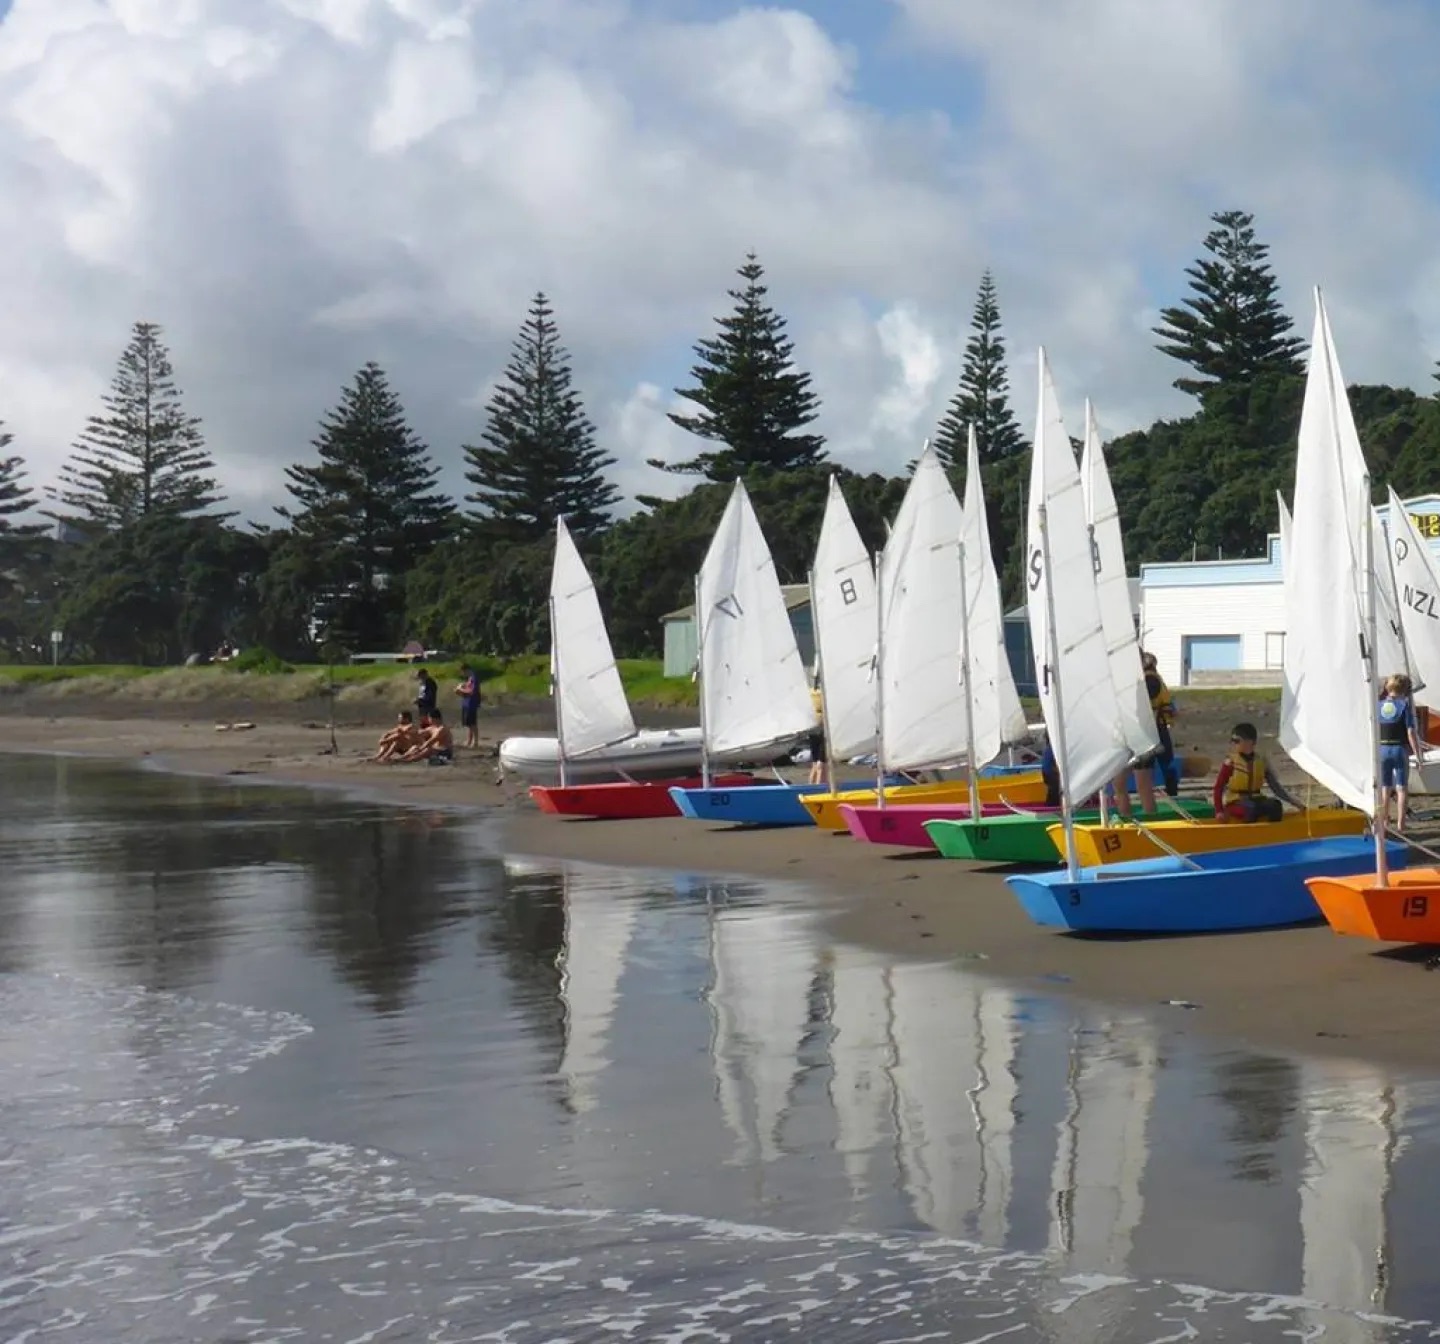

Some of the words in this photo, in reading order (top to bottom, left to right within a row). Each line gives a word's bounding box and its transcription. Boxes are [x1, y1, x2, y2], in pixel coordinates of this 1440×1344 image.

[1429, 515, 1439, 526] P
[1429, 525, 1439, 535] C
[839, 578, 858, 605] 8
[1404, 584, 1439, 620] NZL
[710, 793, 731, 807] 20
[1103, 833, 1122, 853] 13
[1069, 888, 1081, 906] 3
[1402, 896, 1428, 917] 19
